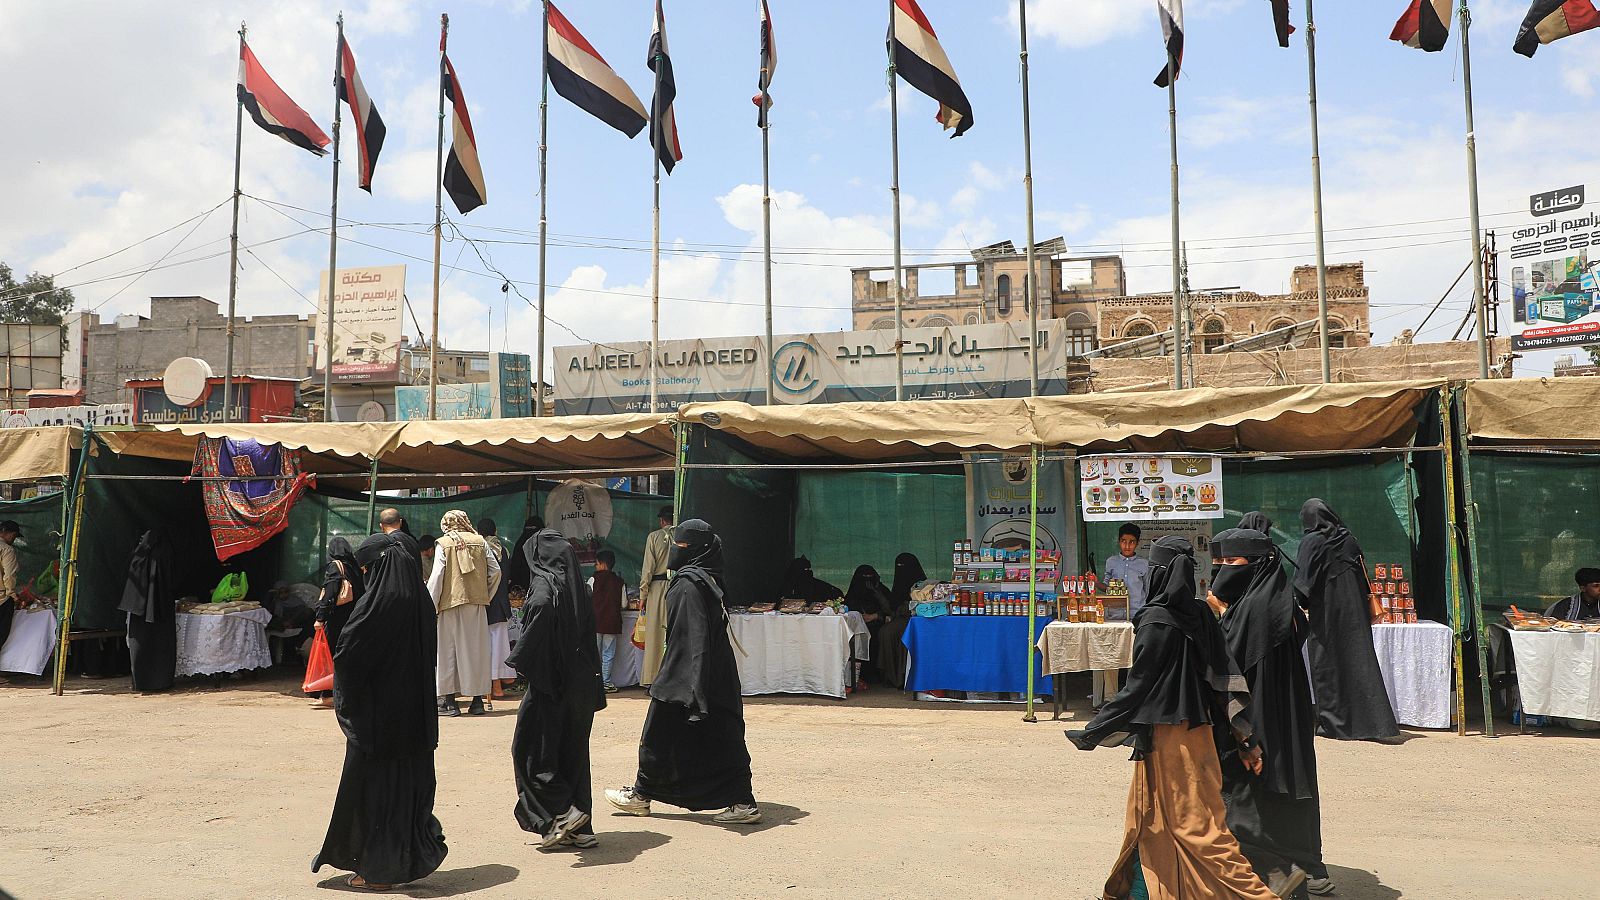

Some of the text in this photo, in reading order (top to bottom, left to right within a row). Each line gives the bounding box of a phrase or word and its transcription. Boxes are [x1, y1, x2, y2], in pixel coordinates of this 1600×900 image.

[1534, 191, 1581, 213] مكتبة
[1512, 218, 1557, 242] الحزمي
[342, 271, 382, 287] مكتبة
[360, 288, 398, 303] إبراهيم
[835, 330, 1049, 364] الجيل الجديد
[568, 353, 642, 372] ALJEEL
[957, 364, 985, 374] كتب
[622, 378, 650, 387] Books
[908, 389, 975, 401] فرع التحرير
[978, 504, 1014, 518] بعدان
